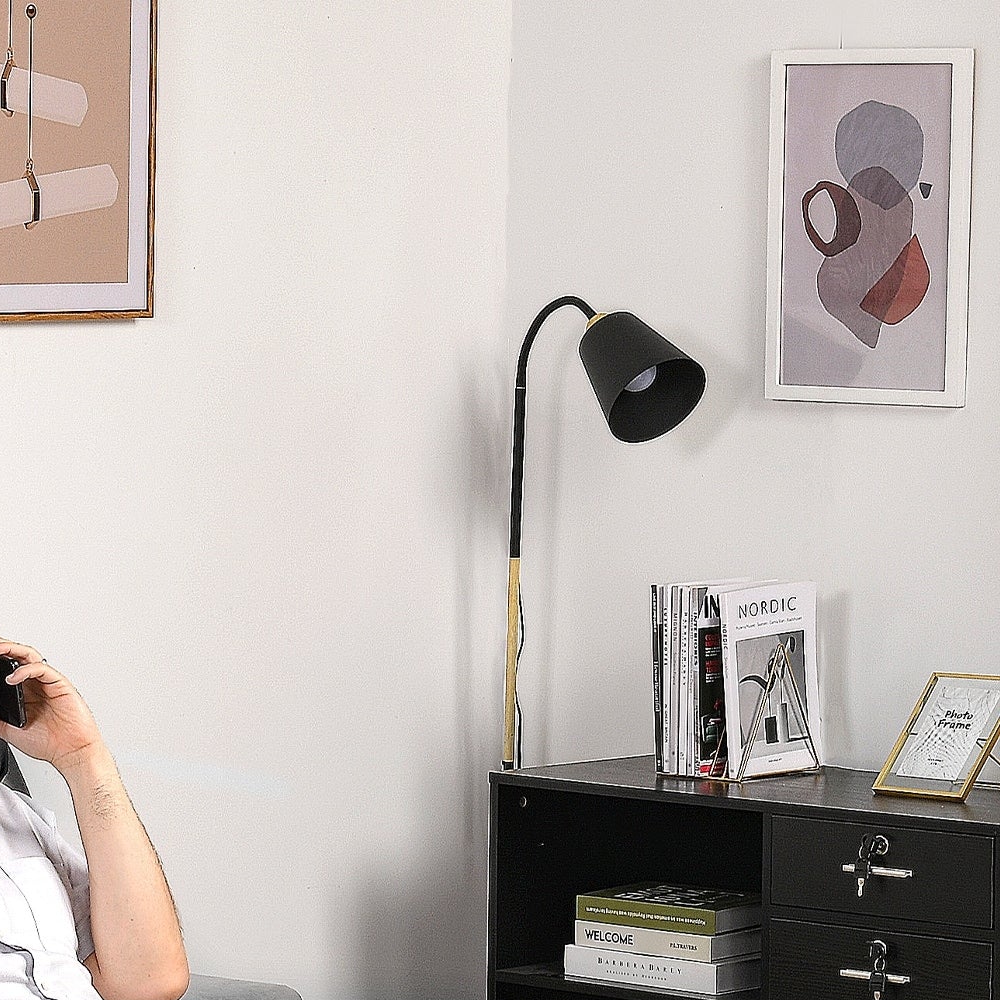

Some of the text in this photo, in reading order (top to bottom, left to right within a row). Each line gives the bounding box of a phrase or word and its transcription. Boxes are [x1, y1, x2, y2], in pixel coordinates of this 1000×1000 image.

[739, 596, 797, 619] NORDIC
[945, 709, 973, 720] Photo
[938, 719, 971, 730] Frame
[585, 928, 634, 946] WELCOME
